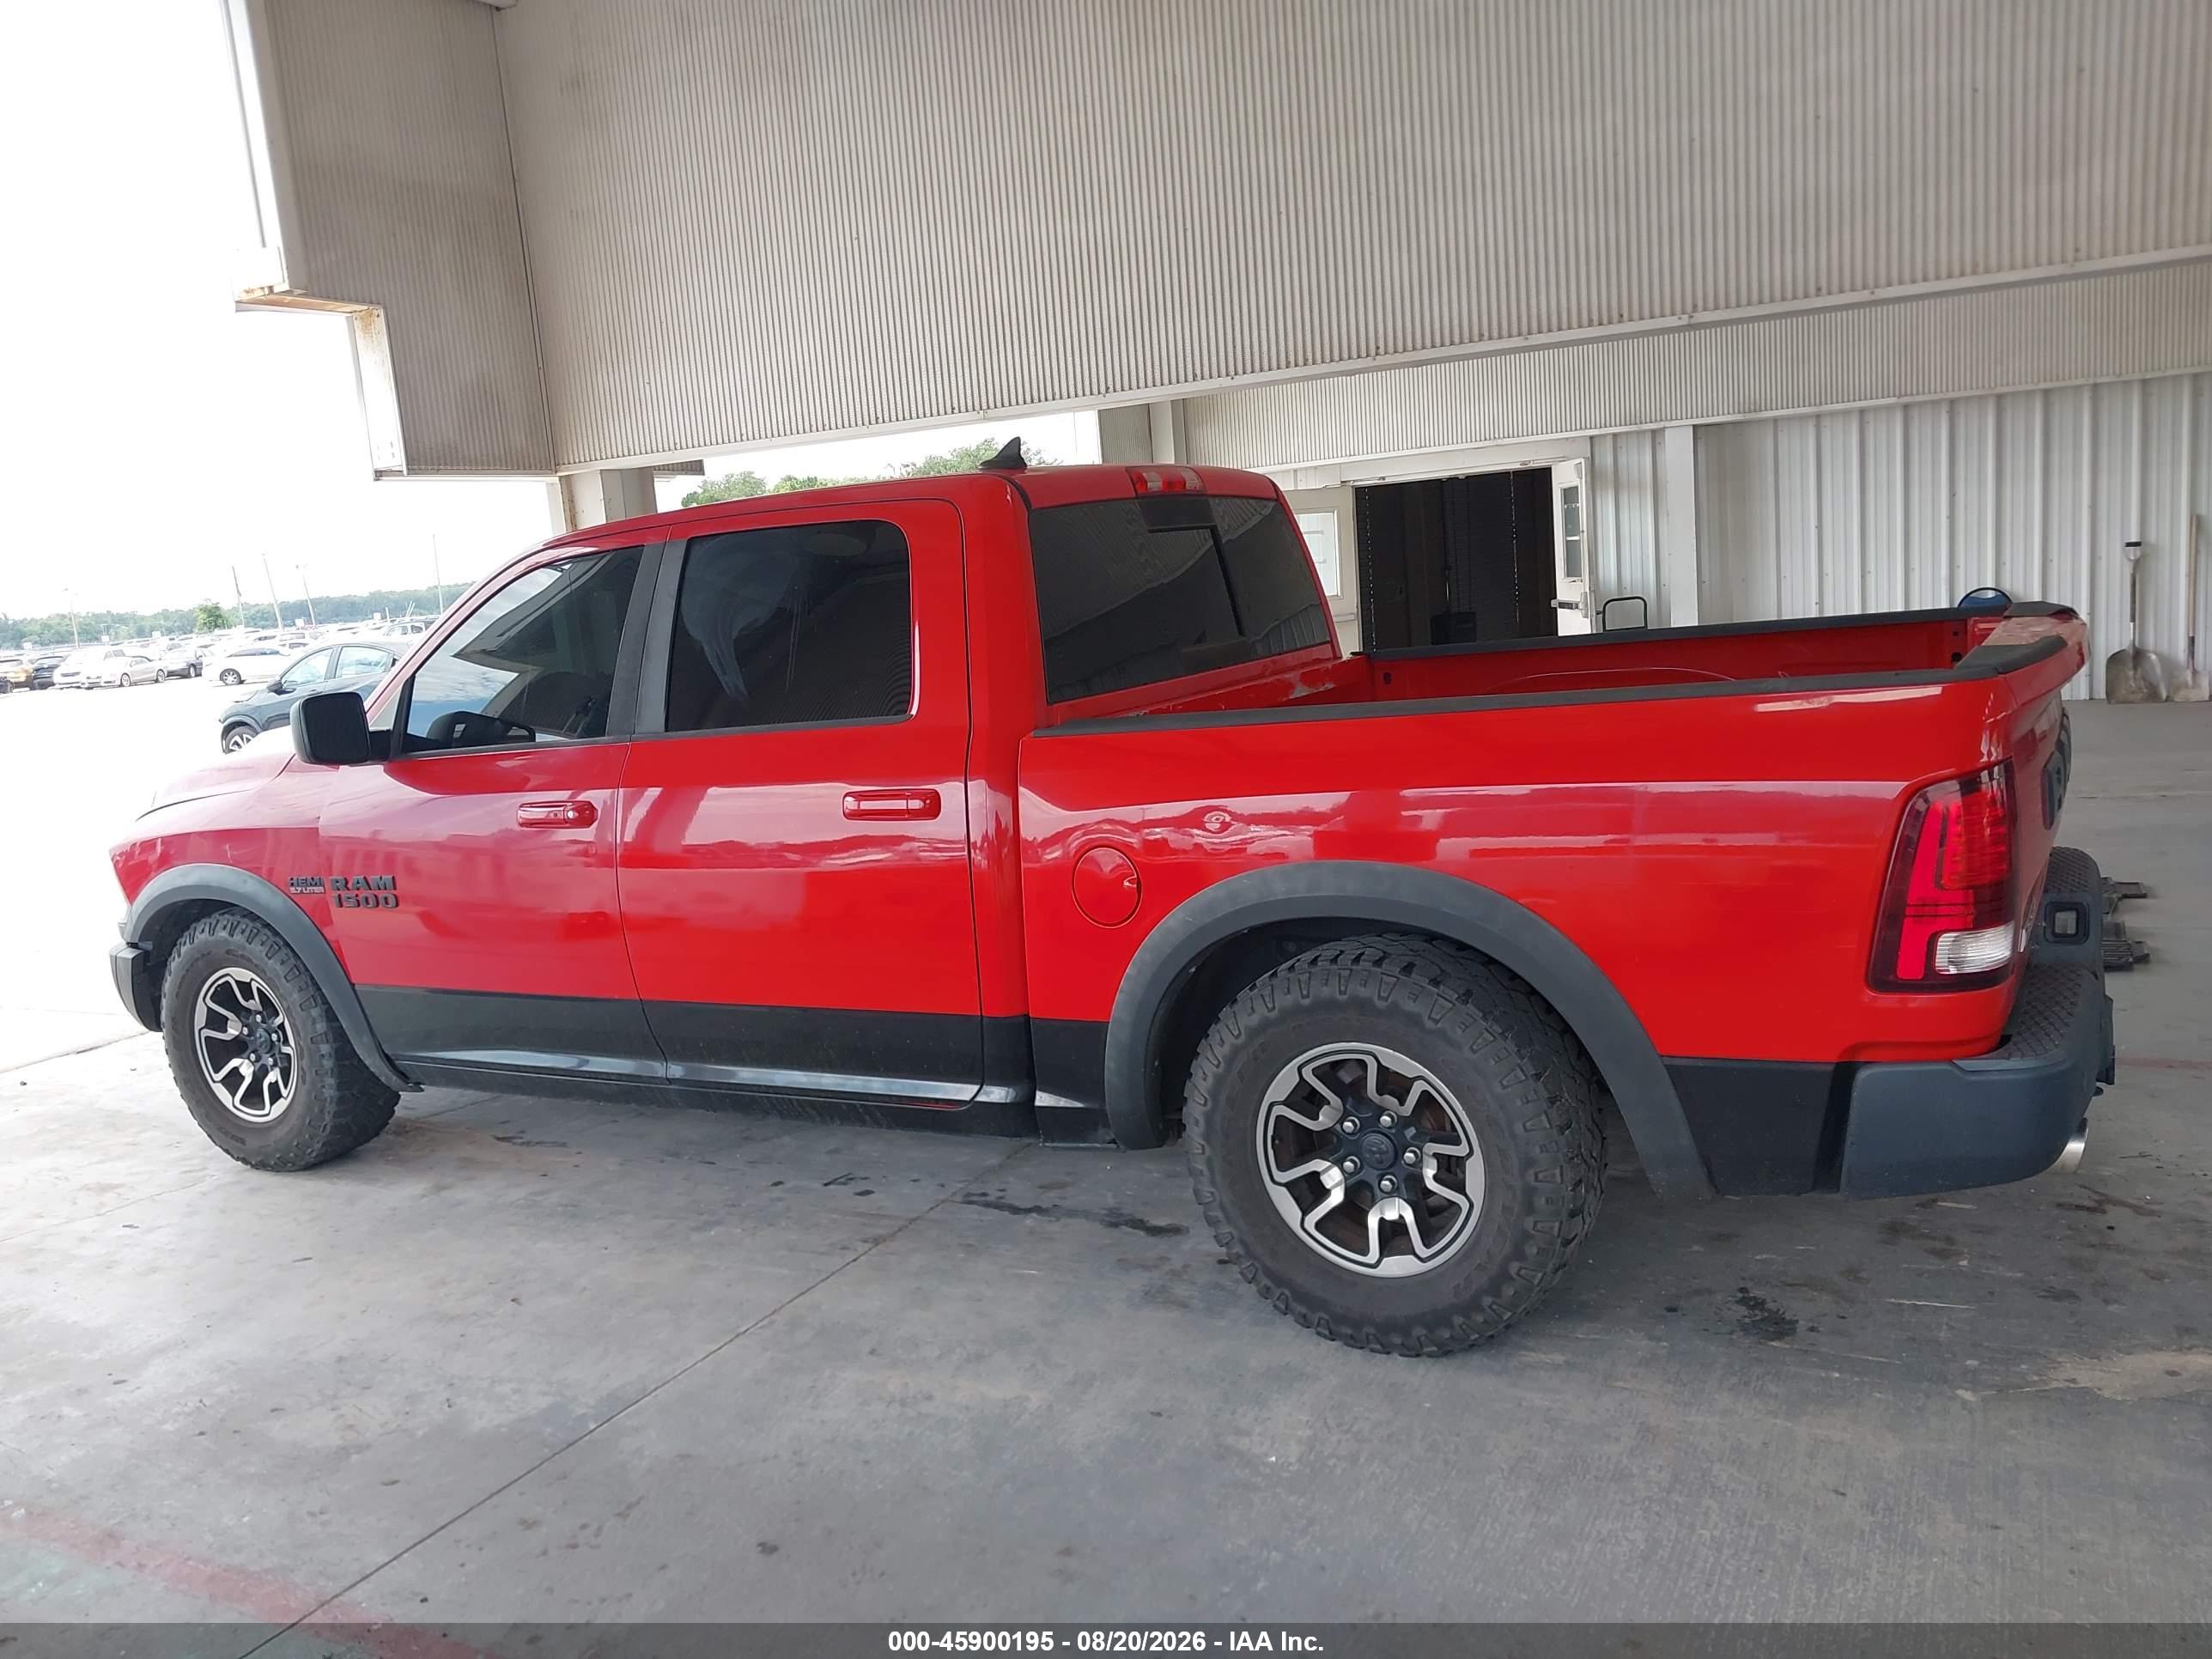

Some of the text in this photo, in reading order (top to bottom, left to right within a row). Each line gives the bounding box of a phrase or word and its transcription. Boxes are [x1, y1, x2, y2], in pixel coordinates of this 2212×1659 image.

[289, 876, 324, 887] HEMI
[330, 875, 396, 891] RAM
[333, 892, 398, 908] 1500
